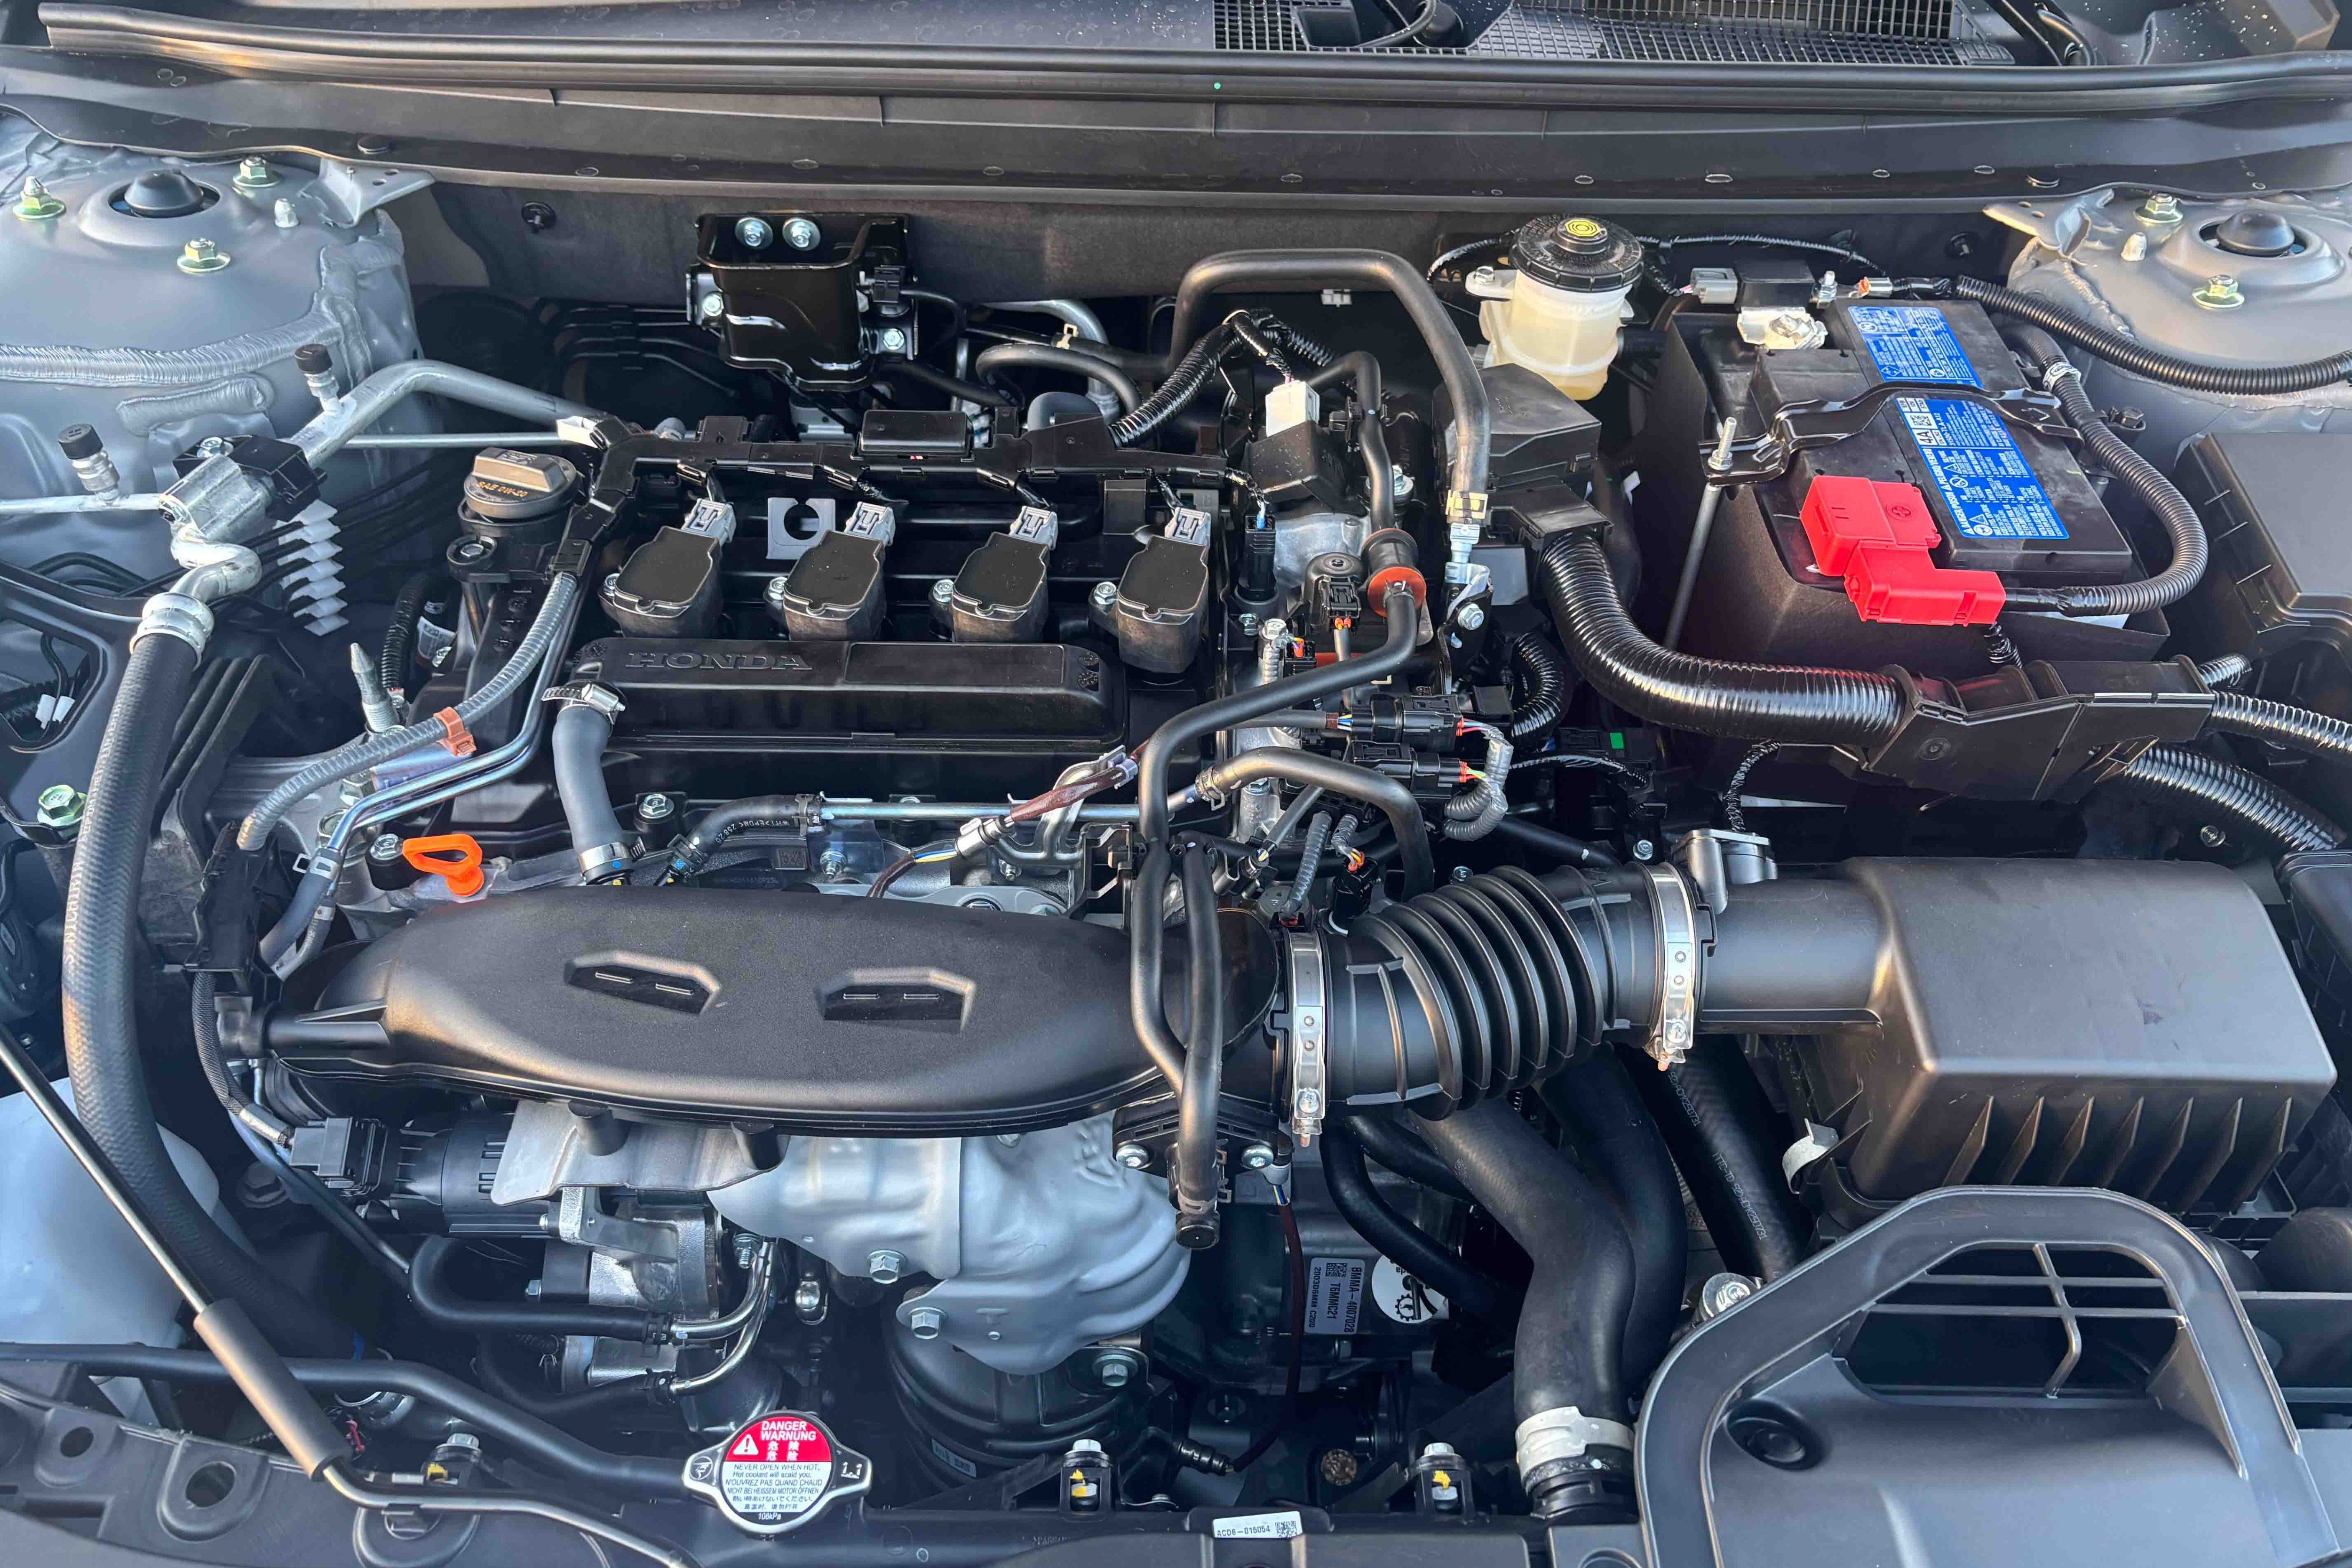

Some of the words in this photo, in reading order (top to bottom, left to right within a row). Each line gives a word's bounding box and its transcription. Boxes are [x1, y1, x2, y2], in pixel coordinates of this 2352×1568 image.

[1915, 430, 1935, 443] 4A
[477, 481, 500, 491] SAE
[499, 486, 528, 497] 0W-20
[625, 652, 813, 670] HONDA
[1327, 1282, 1341, 1319] T6MMC21
[1344, 1267, 1362, 1332] BMMA-4007028
[762, 1421, 807, 1430] DANGER
[761, 1431, 816, 1441] WARNUNG
[1217, 1525, 1270, 1537] ACD6-015054
